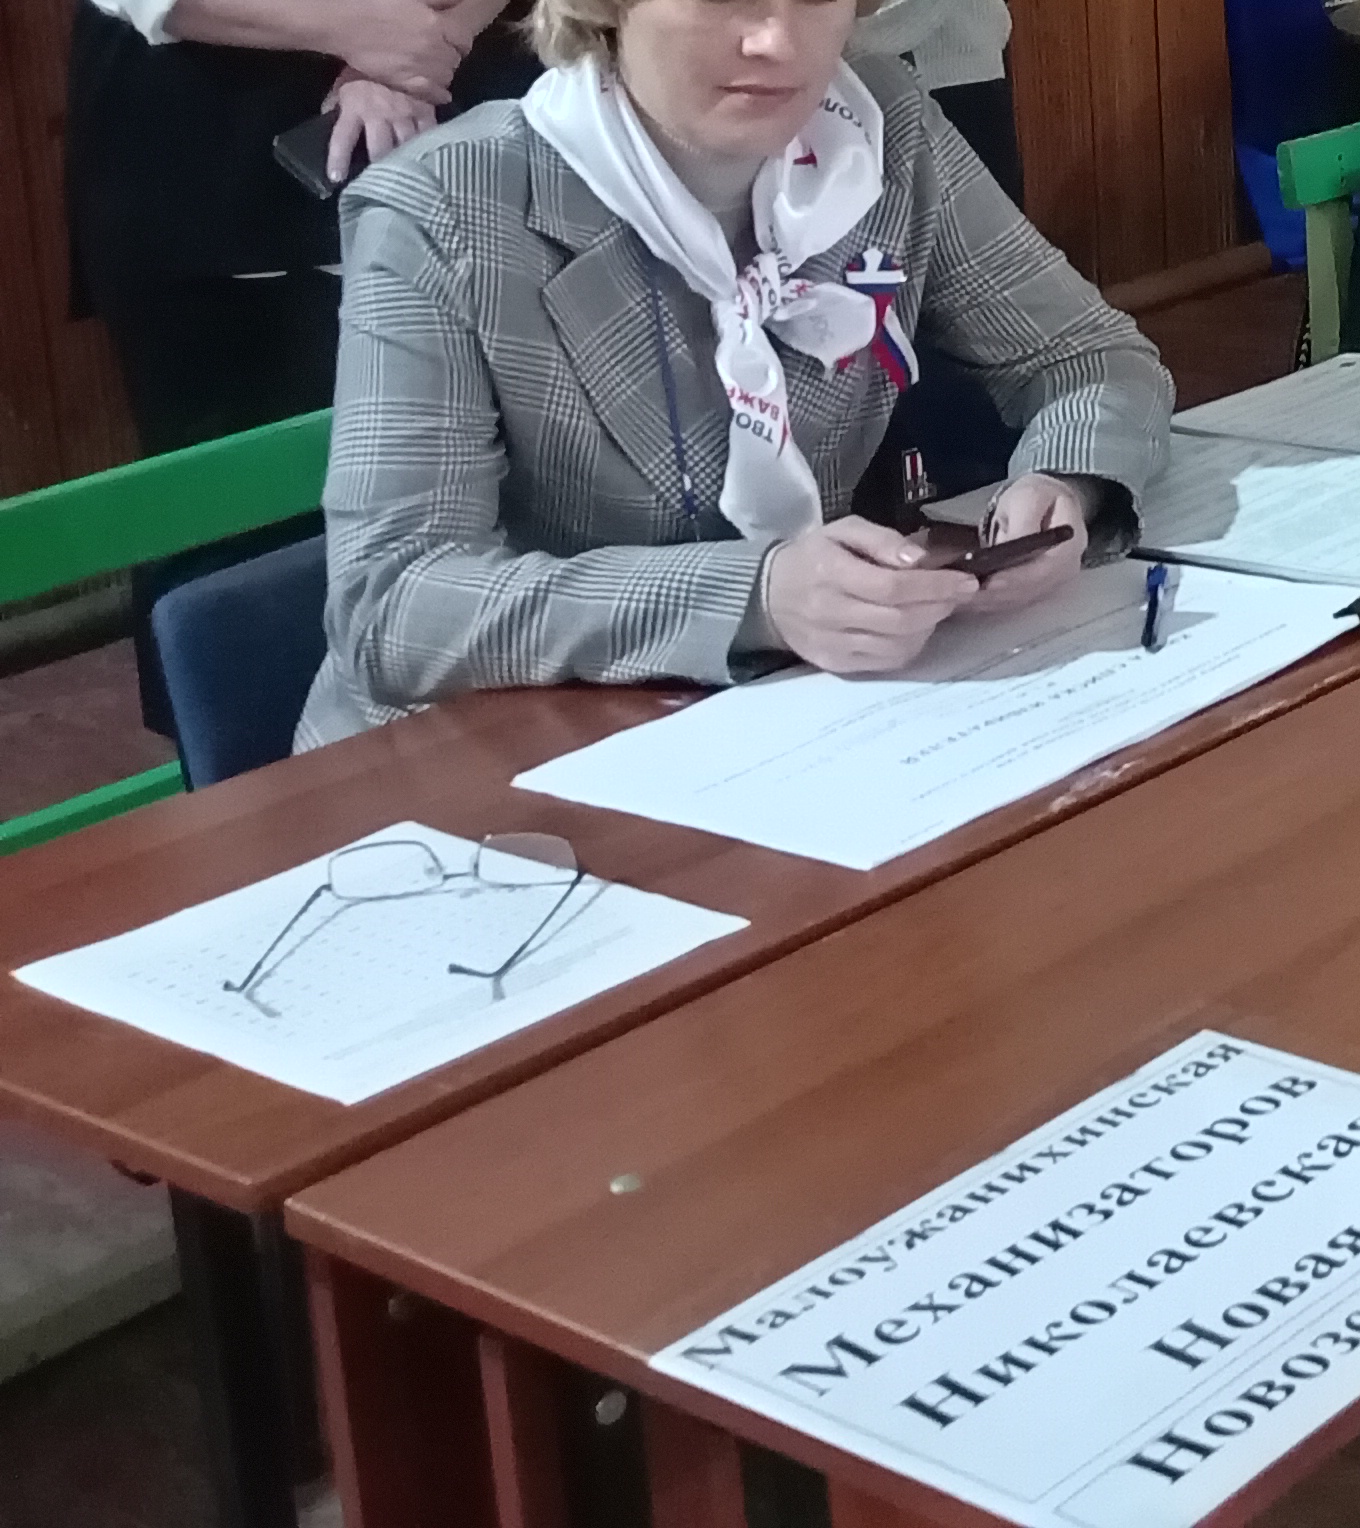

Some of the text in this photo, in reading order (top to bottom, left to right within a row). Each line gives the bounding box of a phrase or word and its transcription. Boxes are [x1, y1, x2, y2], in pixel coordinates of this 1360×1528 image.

[819, 98, 862, 128] ГОЛ
[735, 412, 773, 444] ТВО
[679, 1042, 1244, 1370] Малоужанихинская
[778, 1071, 1319, 1397] Механизаторов
